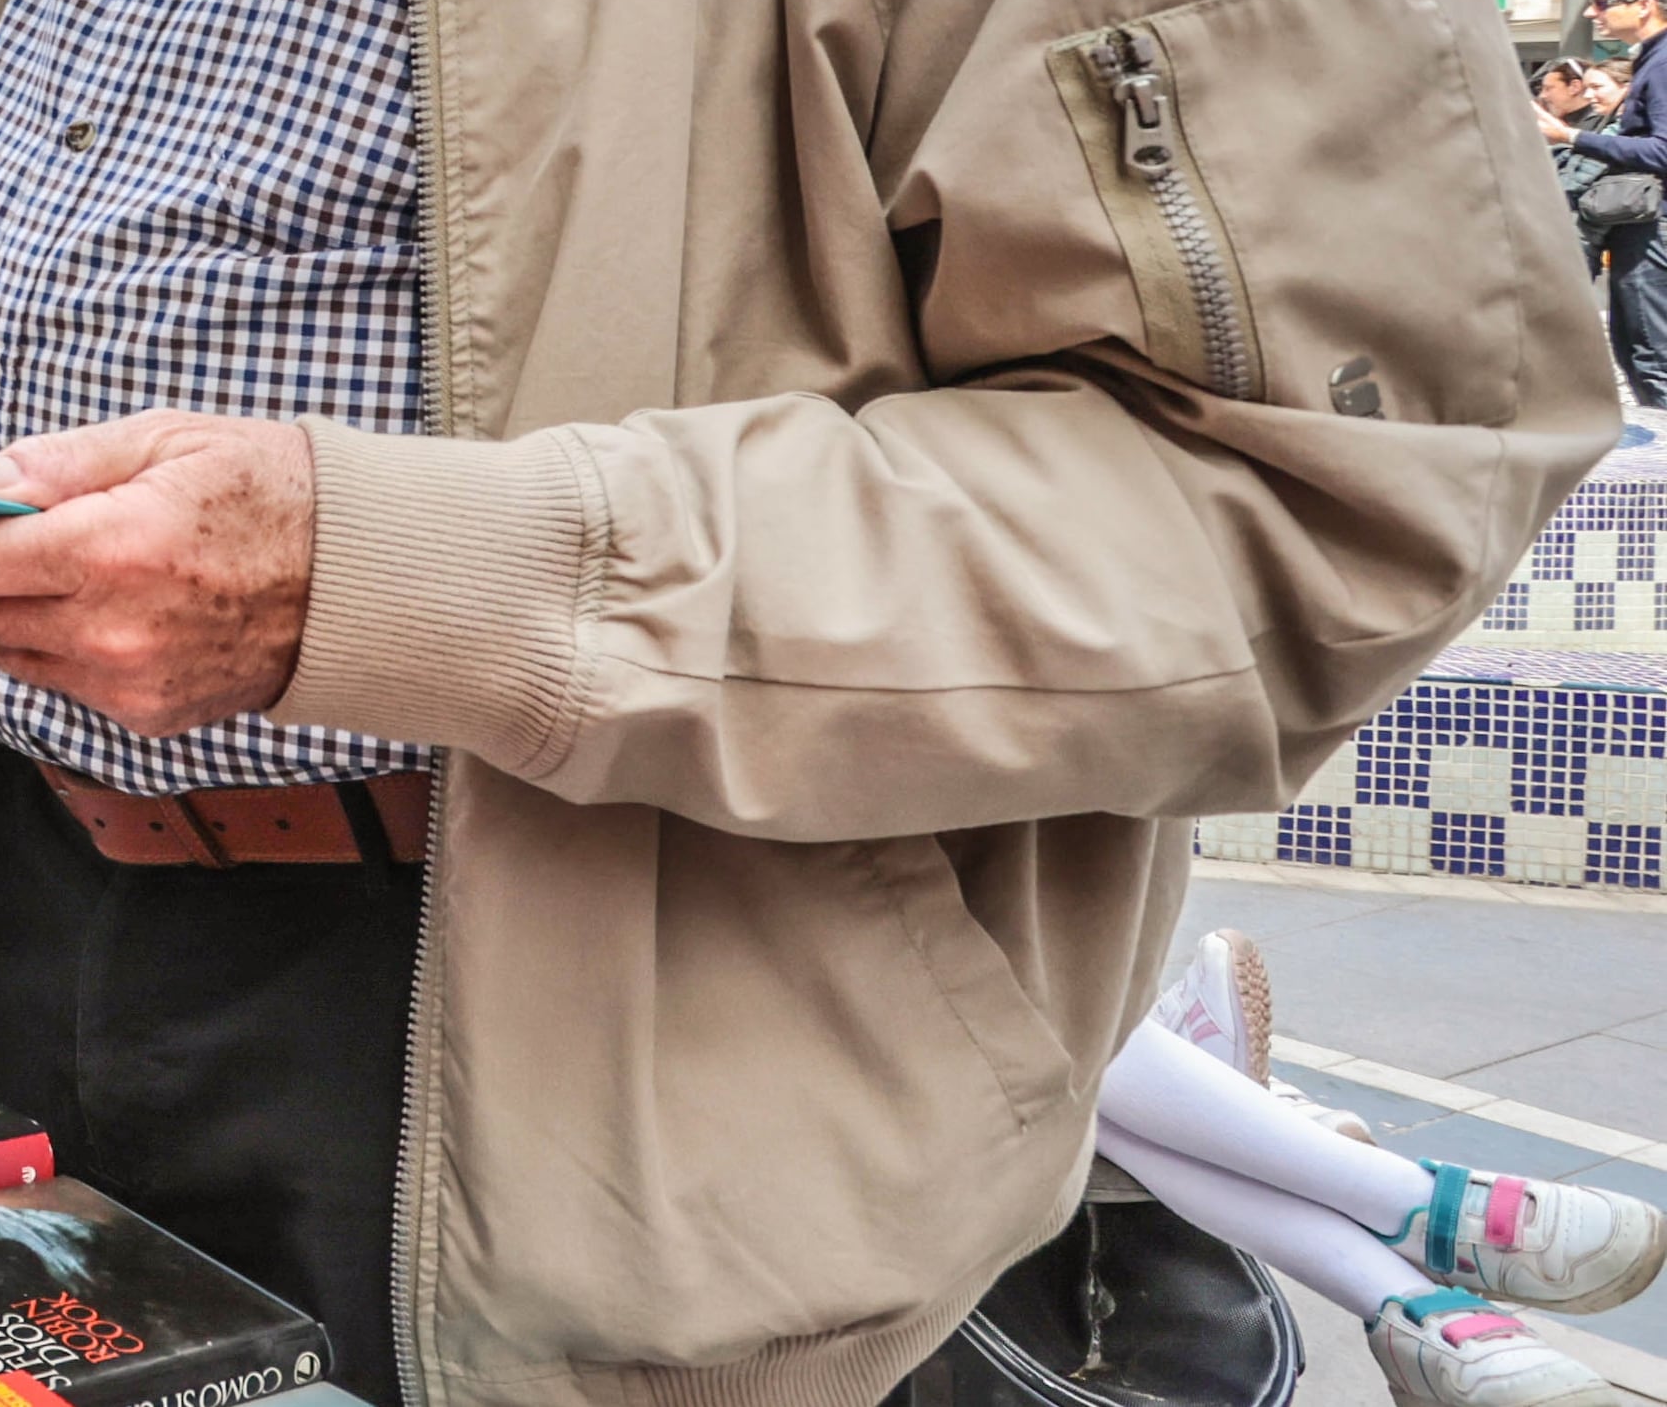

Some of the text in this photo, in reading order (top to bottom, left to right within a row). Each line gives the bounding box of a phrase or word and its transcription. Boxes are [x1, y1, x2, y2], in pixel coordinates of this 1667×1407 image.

[10, 1299, 119, 1364] ROBIN
[40, 1290, 145, 1354] COOK
[202, 1366, 283, 1407] COMO
